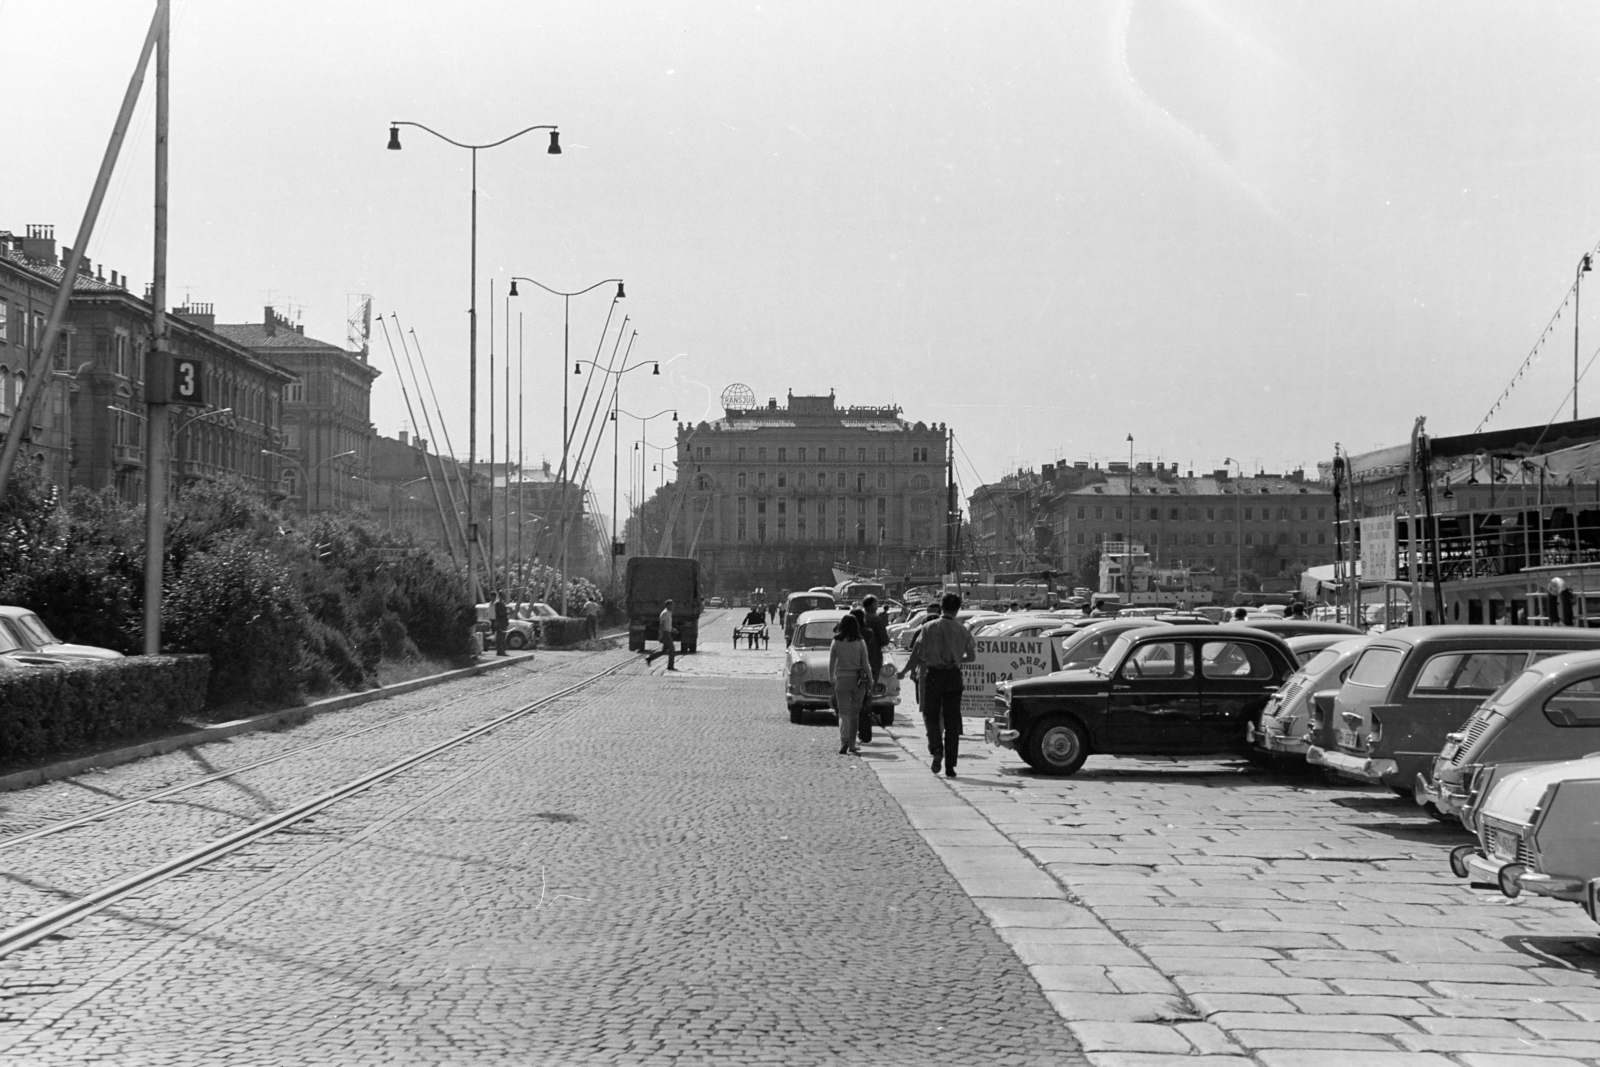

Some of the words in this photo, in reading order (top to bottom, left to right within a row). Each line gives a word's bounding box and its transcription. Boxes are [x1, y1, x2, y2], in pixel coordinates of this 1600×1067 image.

[179, 363, 194, 396] 3
[977, 641, 1043, 654] STAURANT
[1010, 656, 1047, 671] BARBA
